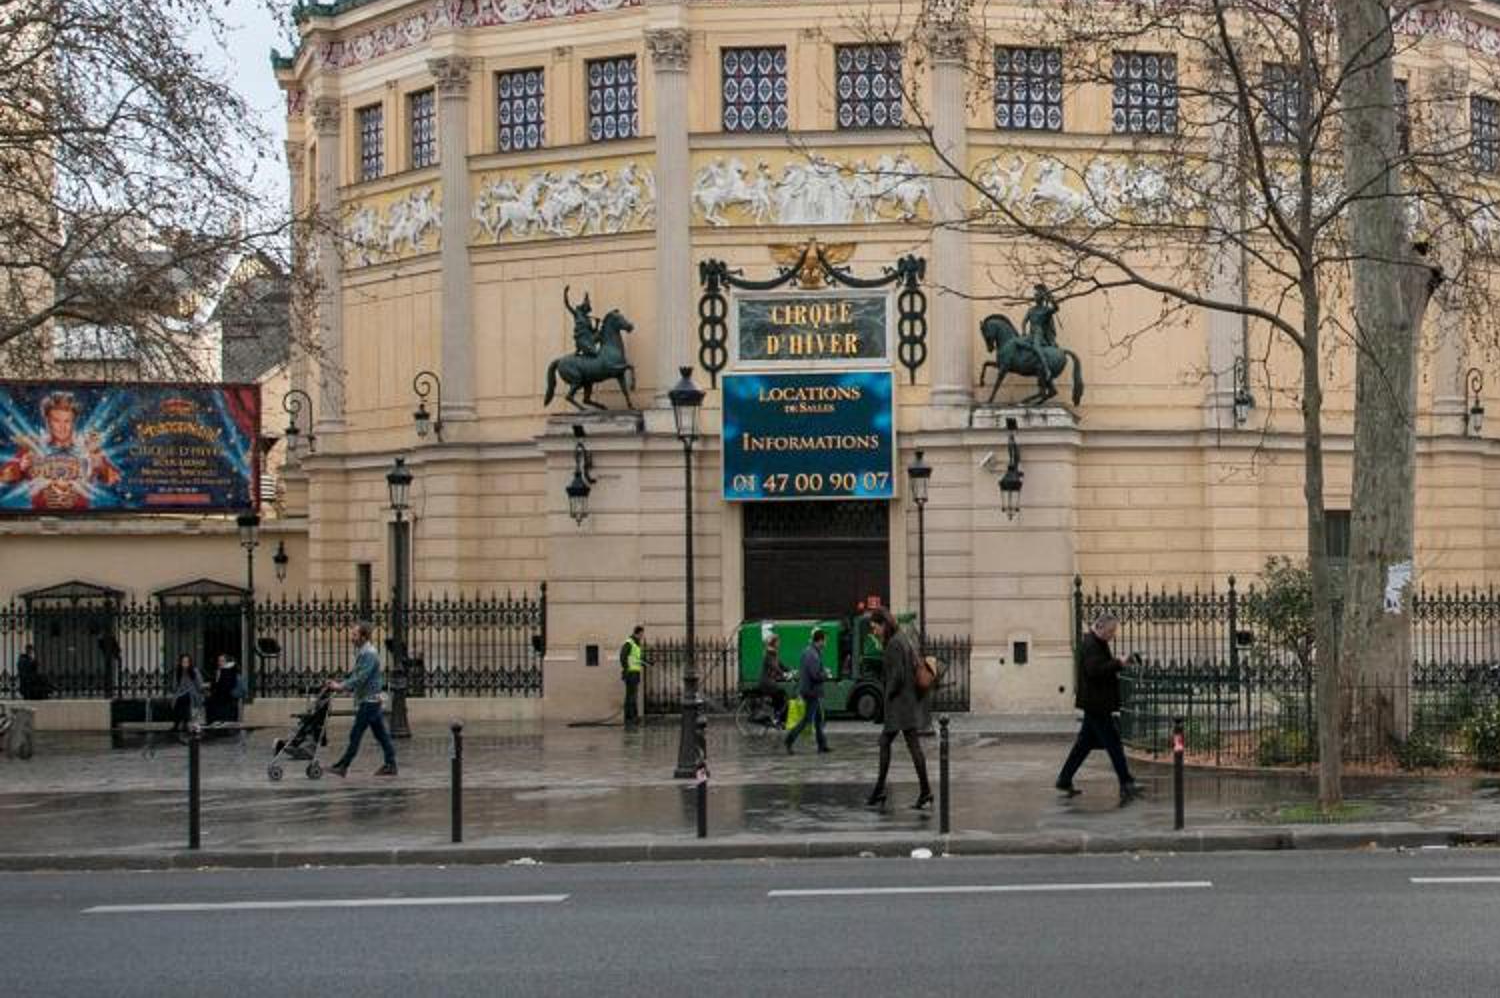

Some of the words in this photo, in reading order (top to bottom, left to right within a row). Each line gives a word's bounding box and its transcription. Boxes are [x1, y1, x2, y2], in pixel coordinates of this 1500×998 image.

[769, 303, 854, 329] CIRQUE
[766, 333, 859, 356] D'HIVER
[758, 385, 862, 402] LOCATIONS
[742, 432, 880, 452] INFORMATIONS
[732, 473, 756, 492] 01
[762, 473, 790, 492] 47
[794, 472, 824, 492] 00
[829, 472, 858, 491] 90
[862, 471, 890, 491] 07
